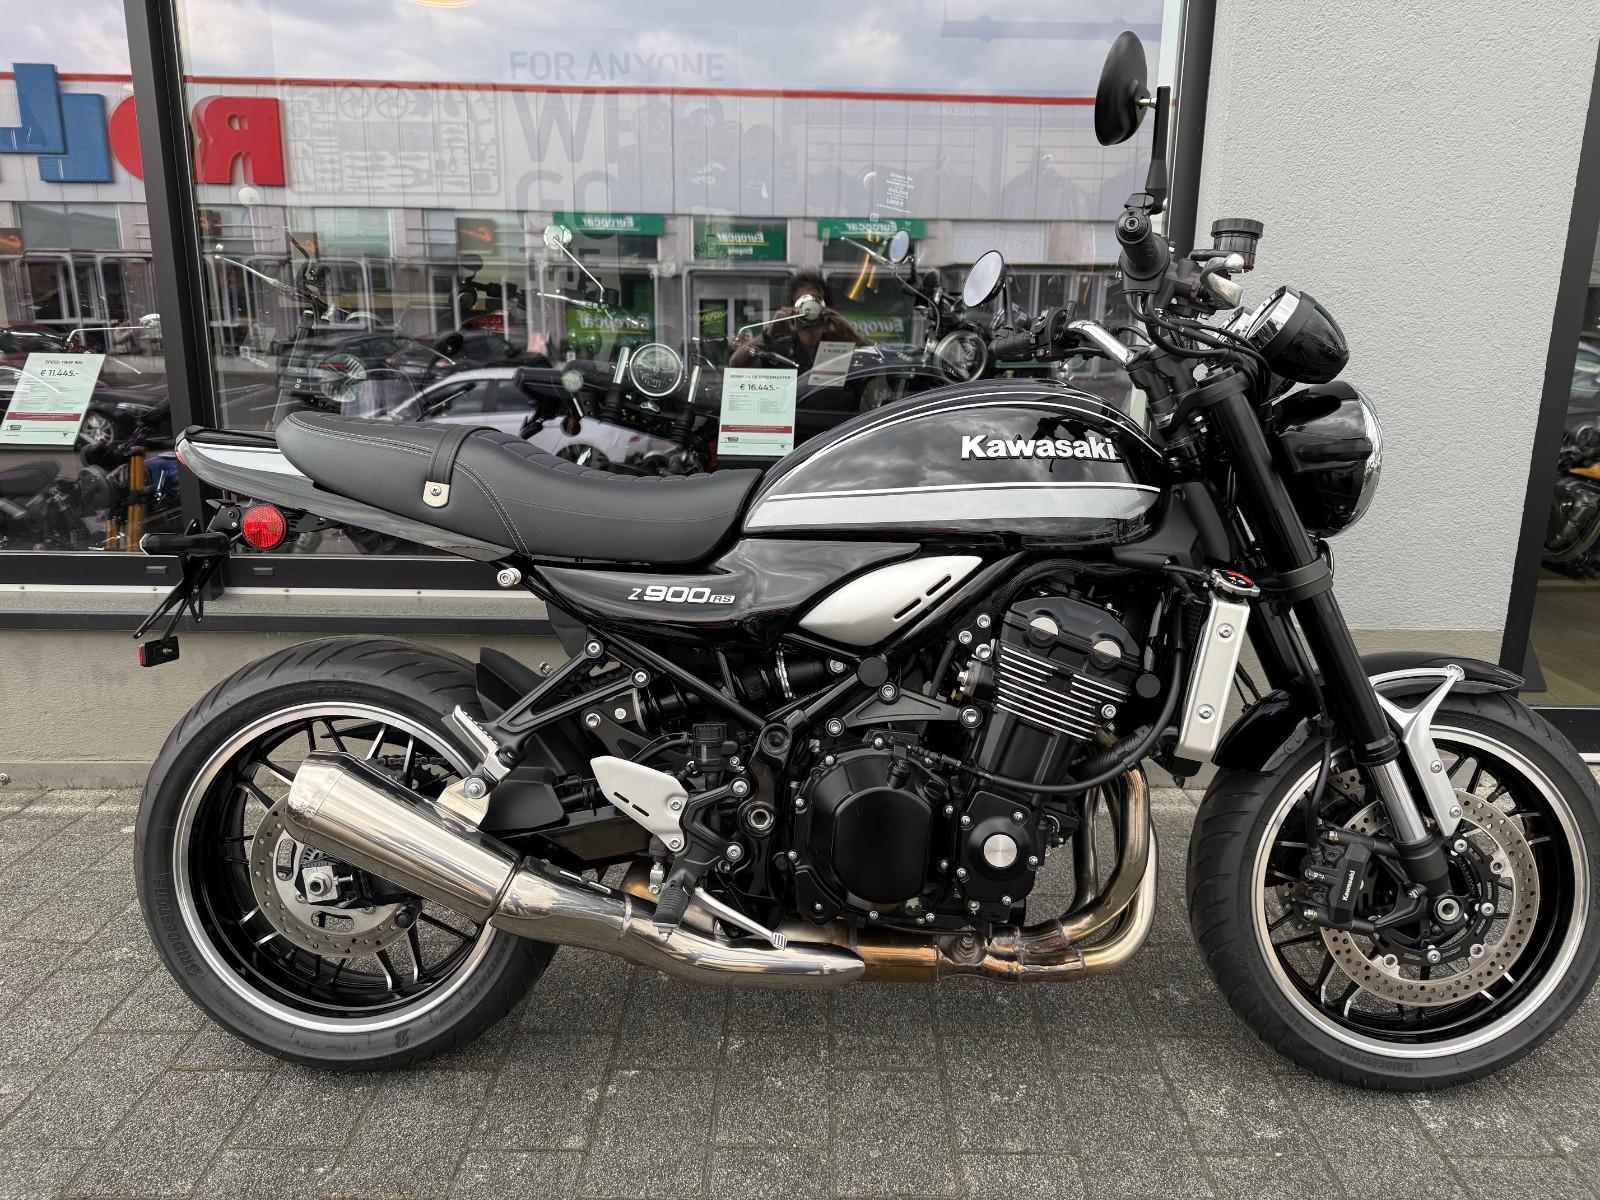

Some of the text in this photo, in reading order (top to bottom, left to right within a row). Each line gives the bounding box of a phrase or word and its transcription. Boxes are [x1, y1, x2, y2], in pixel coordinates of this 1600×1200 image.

[510, 51, 726, 82] FOR ANYONE
[40, 369, 47, 377] €
[740, 383, 746, 391] €
[961, 434, 1117, 460] Kawasaki
[1342, 869, 1356, 902] Kawasaki
